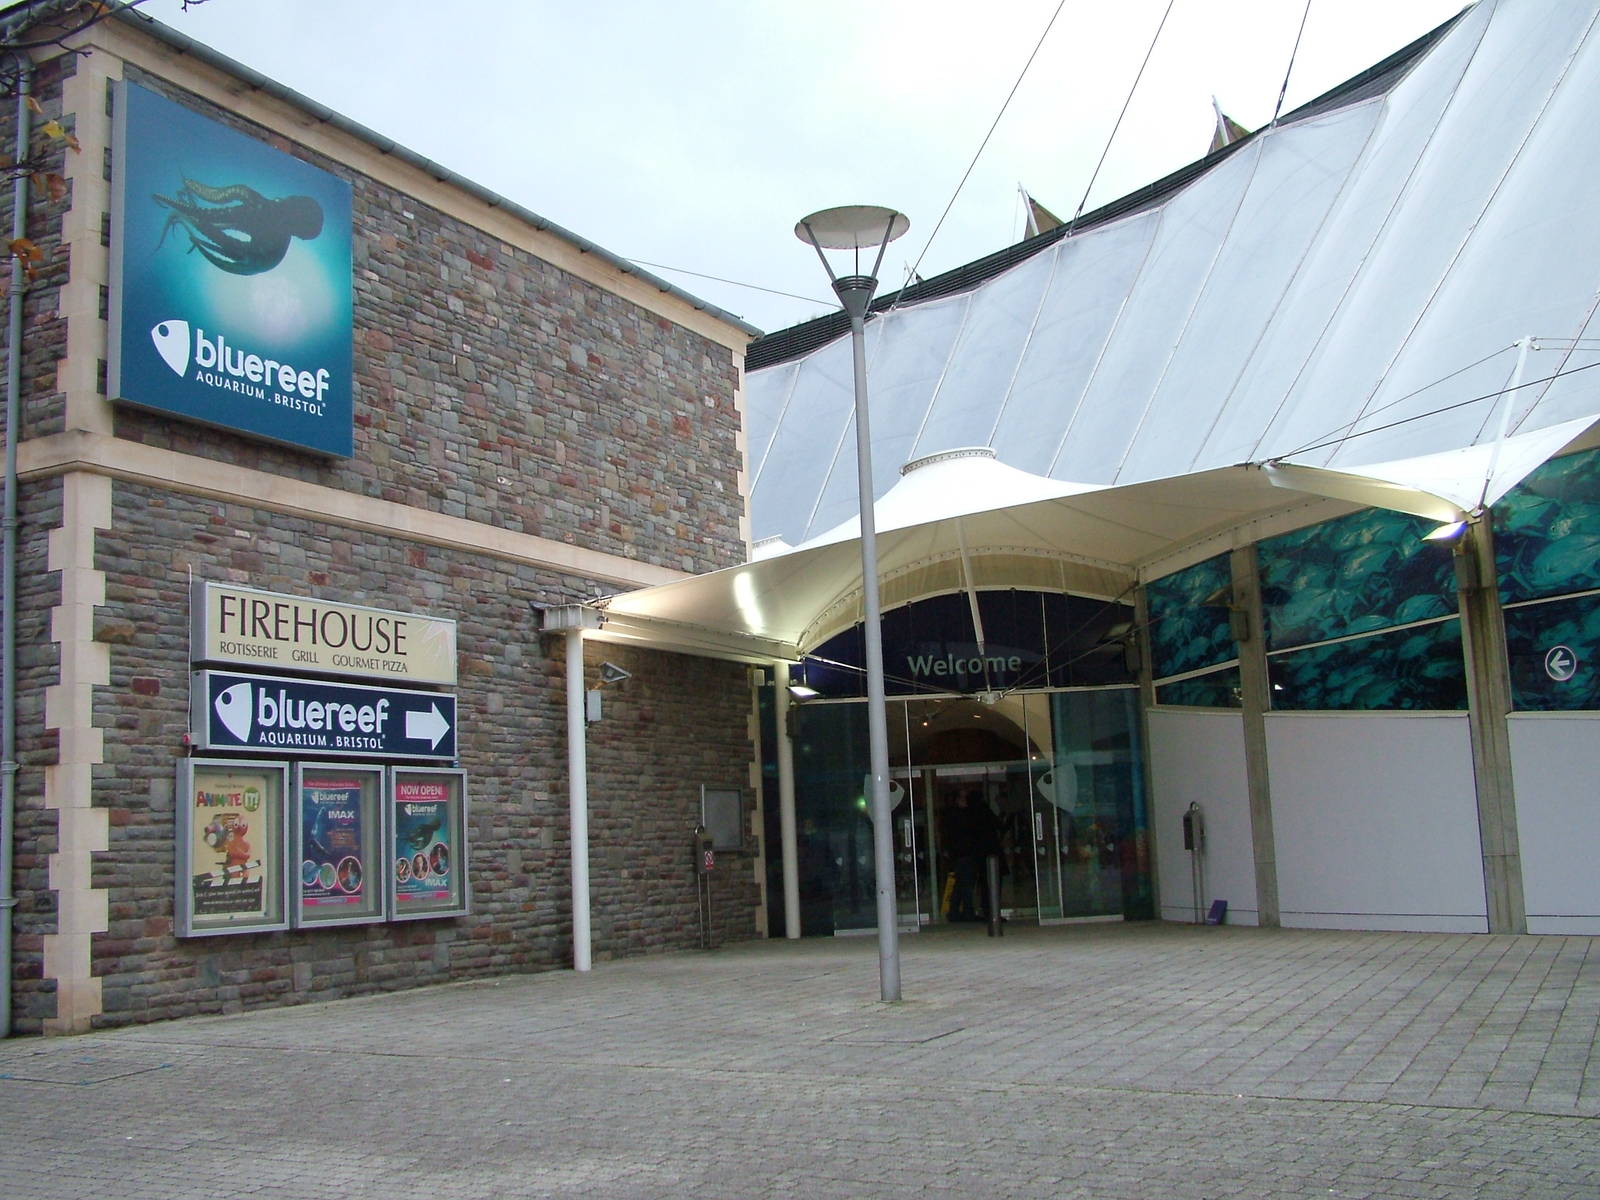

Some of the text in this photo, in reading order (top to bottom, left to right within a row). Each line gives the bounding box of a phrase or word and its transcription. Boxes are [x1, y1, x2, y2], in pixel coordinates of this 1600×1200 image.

[195, 328, 330, 401] bluereef
[196, 371, 323, 417] AQUARIUM BRISTOL
[220, 595, 407, 655] FIREHOUSE
[220, 641, 408, 672] ROTISSERIE GRILL GOURMET PIZZA
[906, 653, 1022, 677] Welcome
[257, 687, 389, 733] bluereef
[259, 731, 383, 749] AQUARIUM BRISTOL
[400, 784, 420, 796] NOW
[328, 810, 354, 819] IMAX
